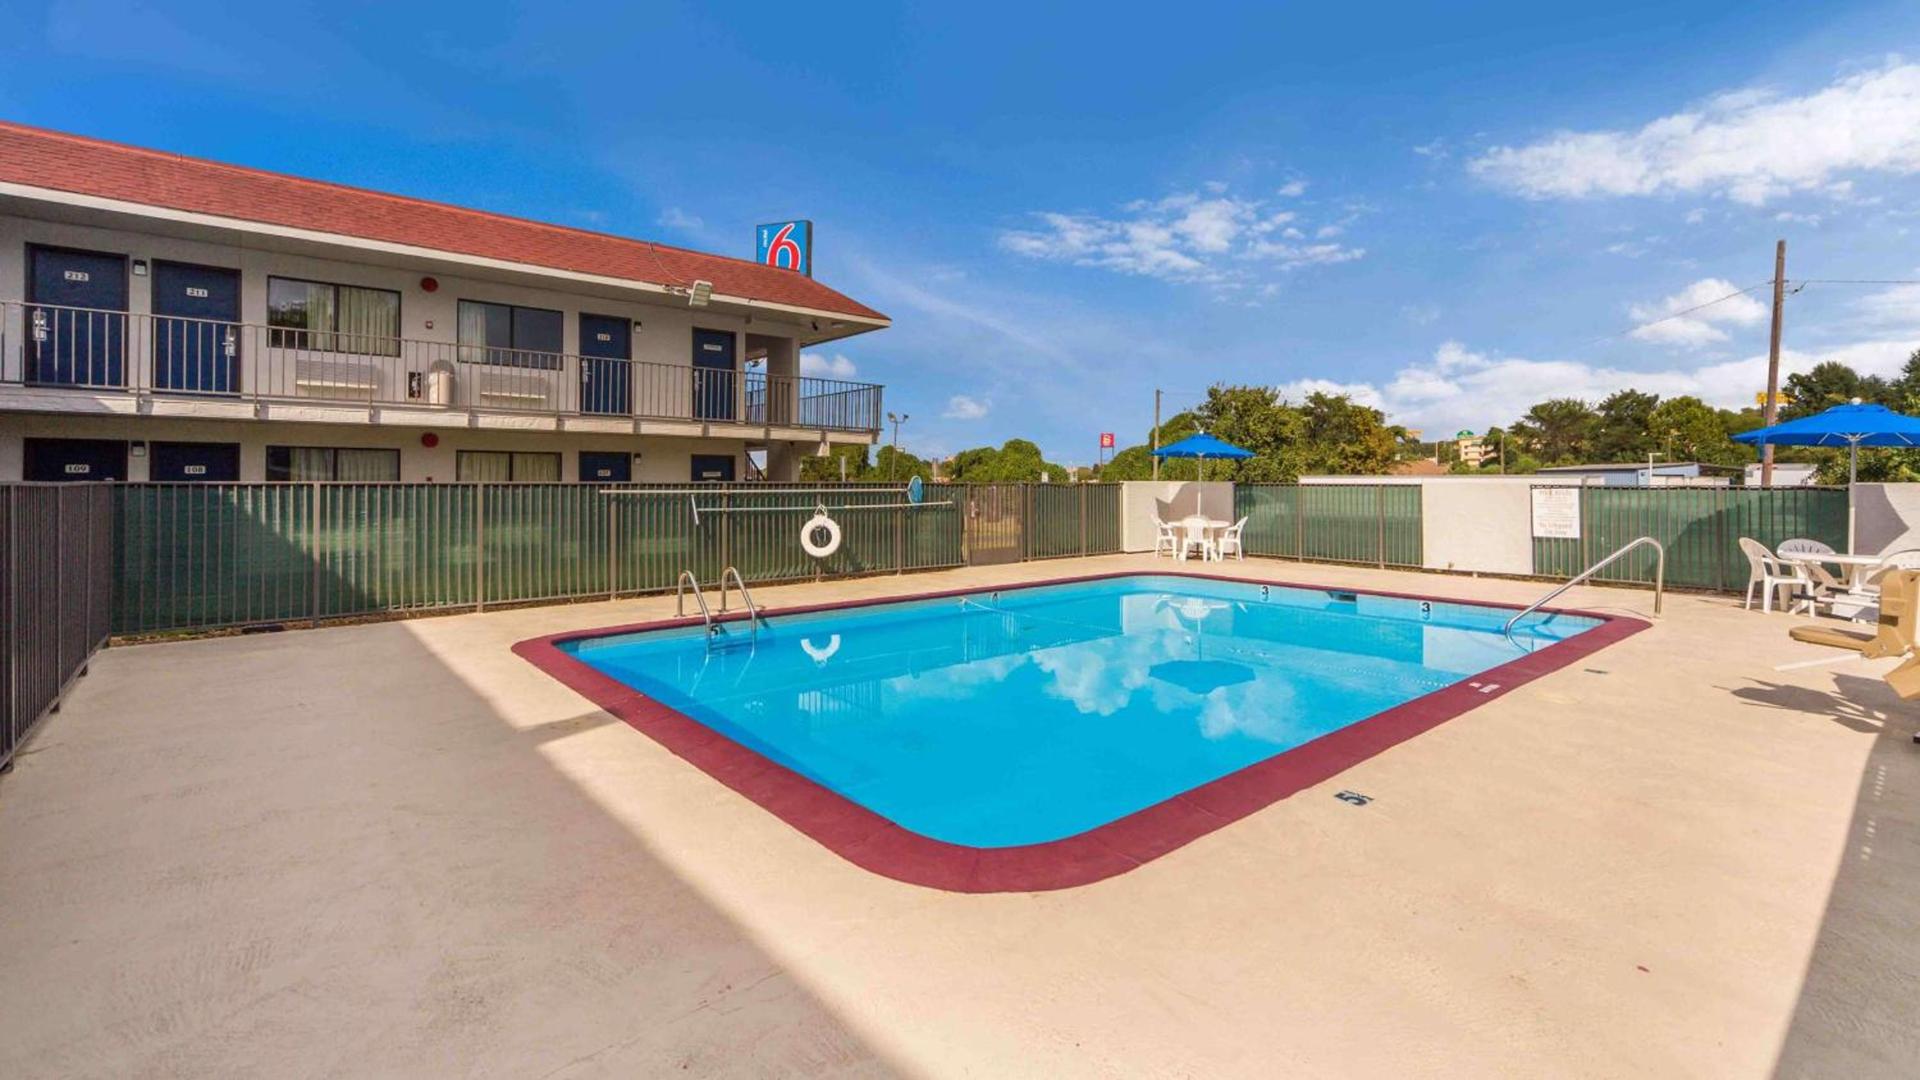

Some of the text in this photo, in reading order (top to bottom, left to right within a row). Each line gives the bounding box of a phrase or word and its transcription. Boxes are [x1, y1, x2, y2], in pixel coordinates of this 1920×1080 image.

[767, 223, 801, 271] 6
[67, 272, 87, 281] 212
[67, 465, 88, 473] 109
[1262, 586, 1269, 595] 3
[1421, 602, 1430, 612] 3
[711, 624, 719, 636] 5
